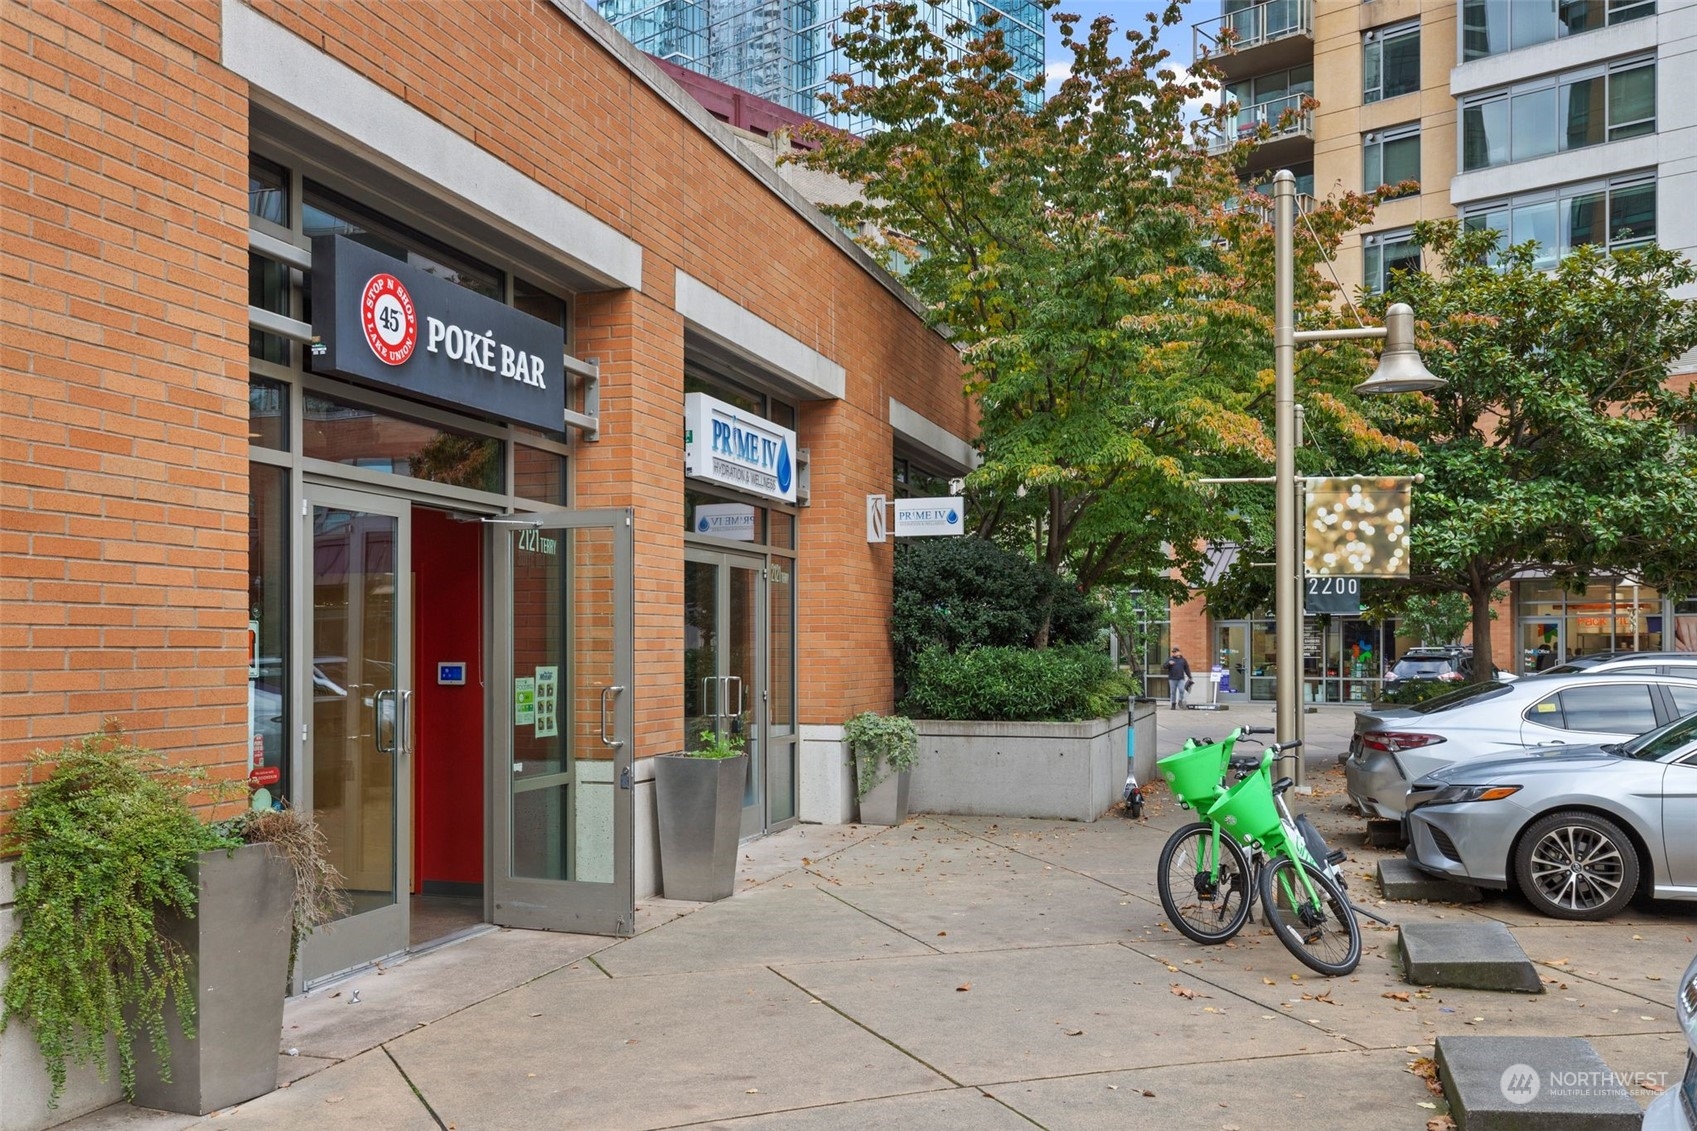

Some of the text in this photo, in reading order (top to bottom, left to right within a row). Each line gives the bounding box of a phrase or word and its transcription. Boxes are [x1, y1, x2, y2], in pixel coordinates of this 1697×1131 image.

[366, 278, 415, 324] STOP N SHOP
[380, 306, 400, 333] 45
[367, 323, 413, 361] LAKE UNION
[426, 316, 547, 389] POKÉ BAR
[761, 437, 778, 471] IV
[712, 460, 745, 483] HYDRATION
[751, 471, 777, 491] WELLNESS
[934, 510, 946, 520] IV
[518, 529, 557, 555] 2121 TERRY
[1308, 577, 1357, 595] 2200
